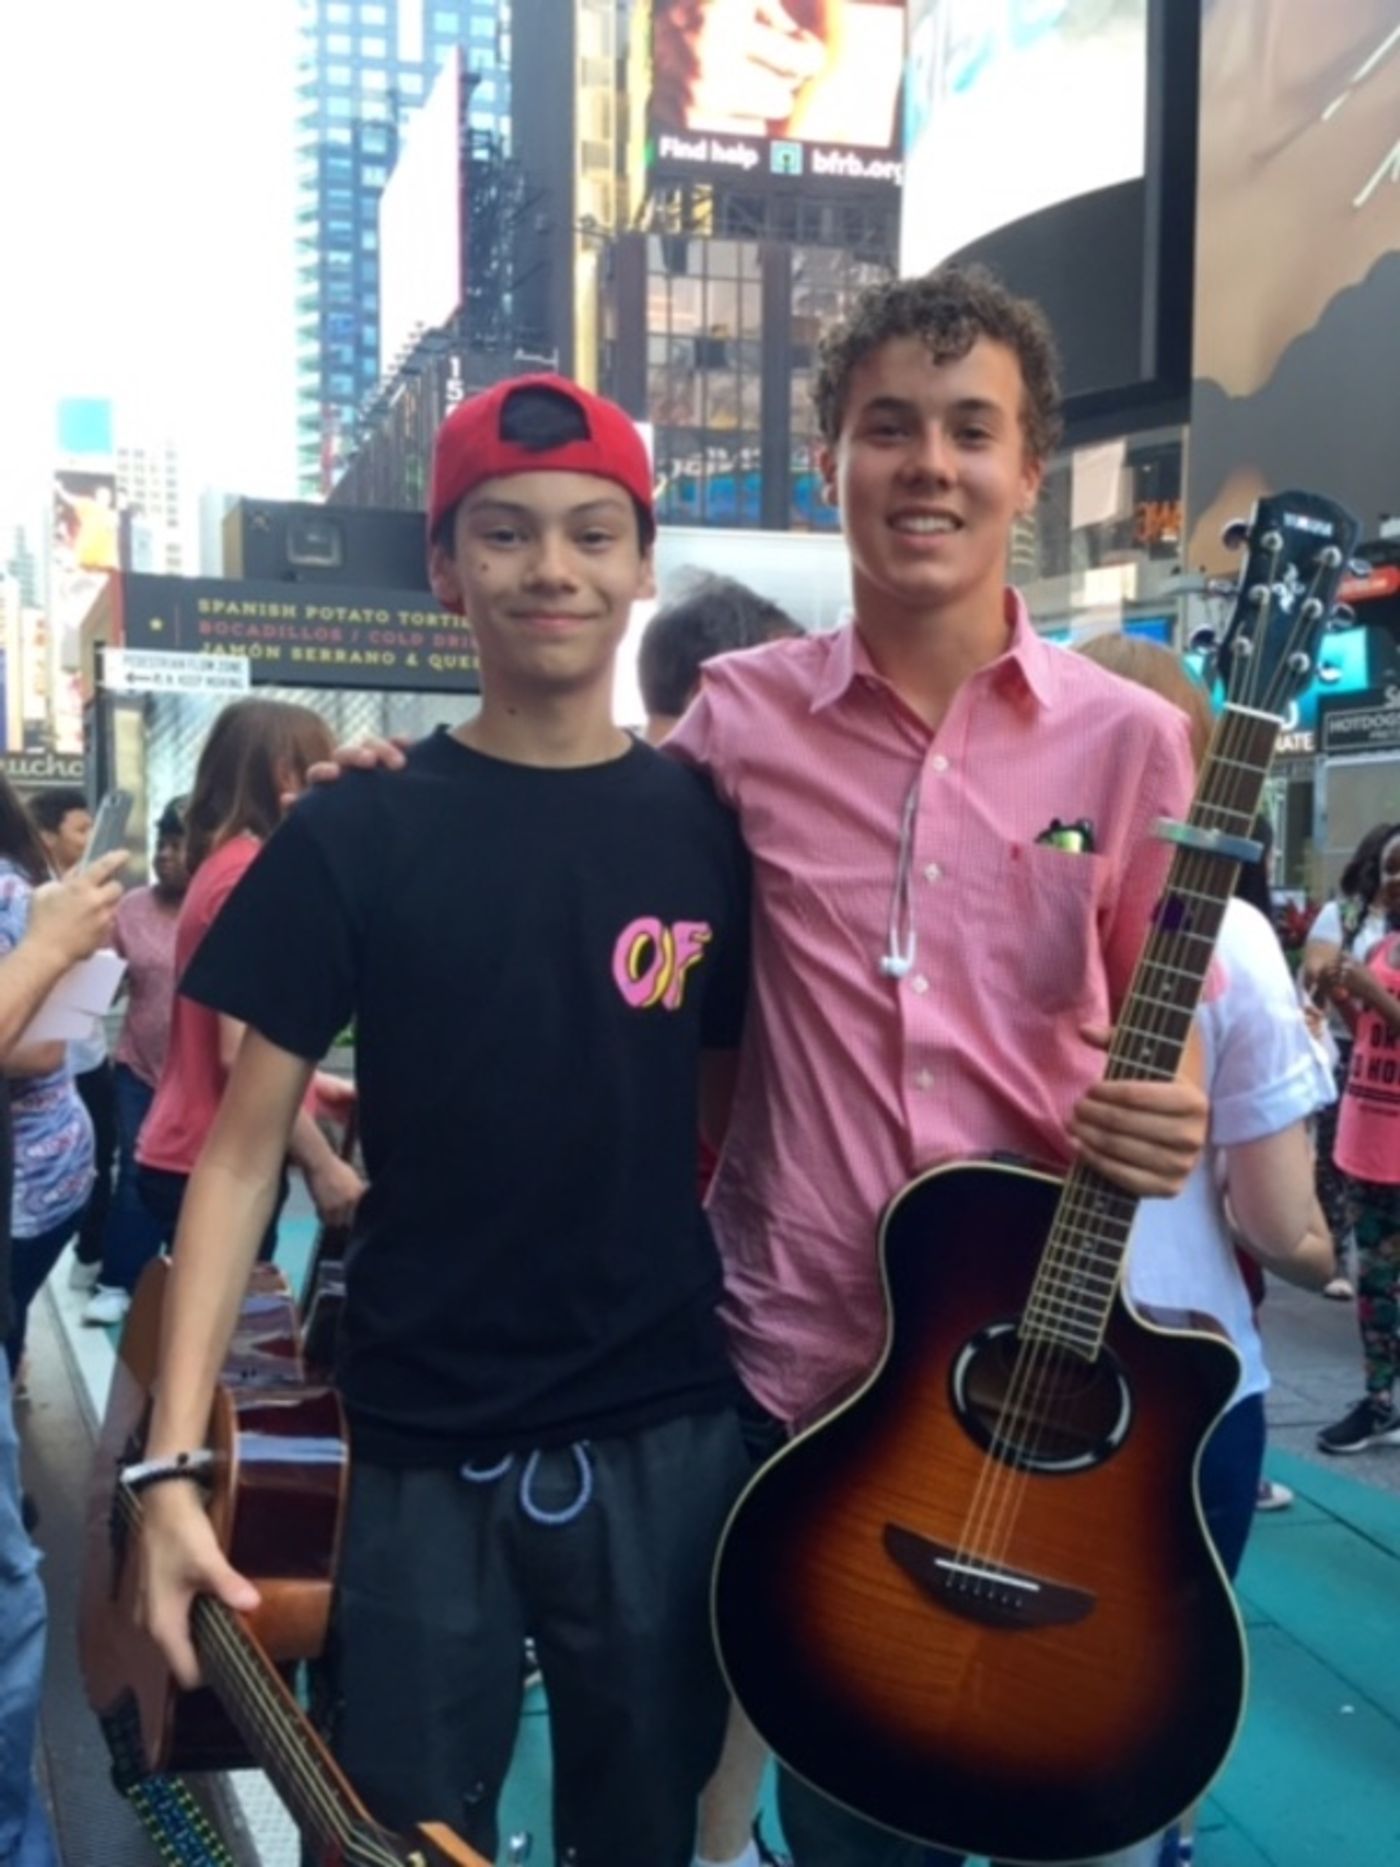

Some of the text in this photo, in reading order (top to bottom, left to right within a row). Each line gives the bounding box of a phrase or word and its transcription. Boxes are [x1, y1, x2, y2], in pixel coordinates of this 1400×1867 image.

[659, 135, 707, 158] Find
[710, 142, 759, 170] help
[198, 599, 297, 619] SPANISH
[305, 605, 390, 626] POTATO
[199, 621, 342, 642] BOCADILLOS
[368, 629, 424, 647] COLD
[291, 647, 396, 667] SERRANO
[405, 652, 420, 667] &
[1329, 712, 1400, 734] HOTDOG
[612, 916, 713, 1012] OF
